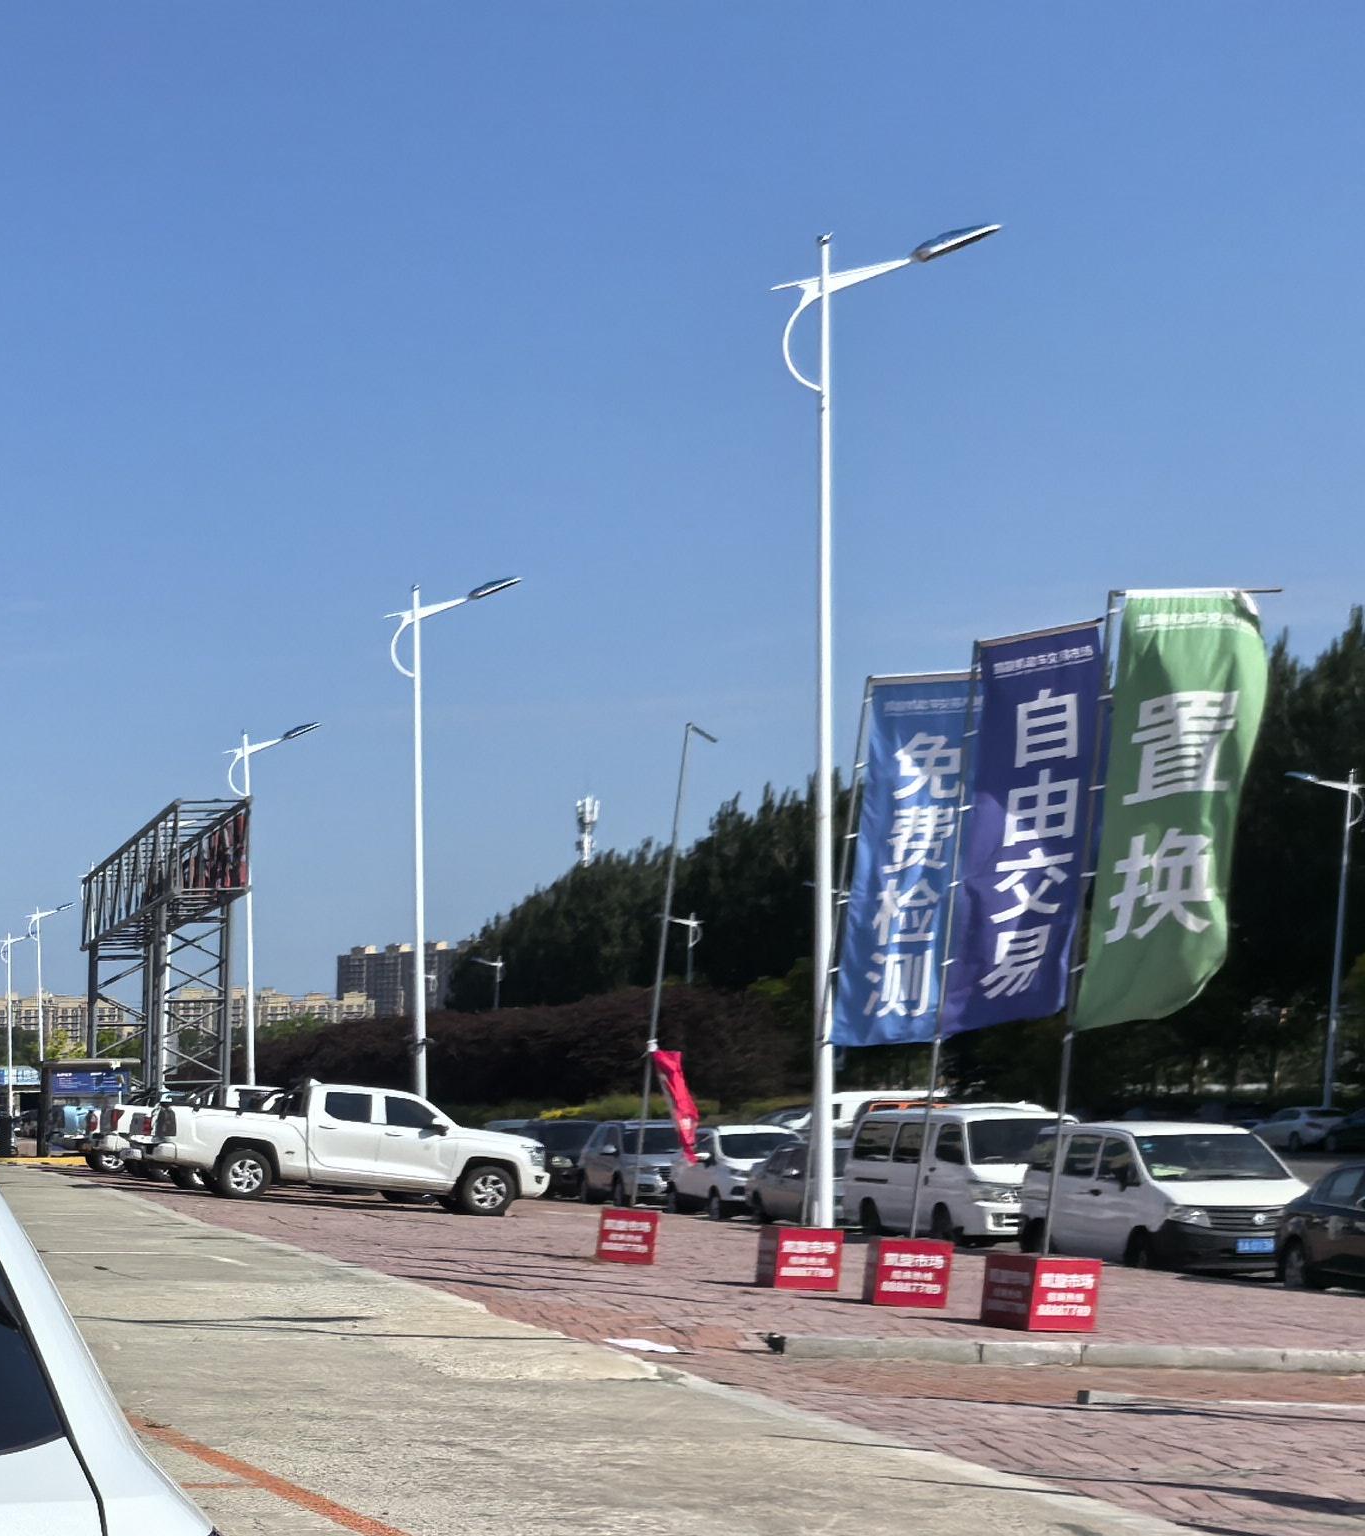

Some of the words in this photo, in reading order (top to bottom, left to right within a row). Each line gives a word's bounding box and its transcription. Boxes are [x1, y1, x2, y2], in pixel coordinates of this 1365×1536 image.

[863, 732, 962, 1017] 免费检测
[980, 688, 1079, 1000] 自由交易
[1105, 690, 1239, 944] 置换
